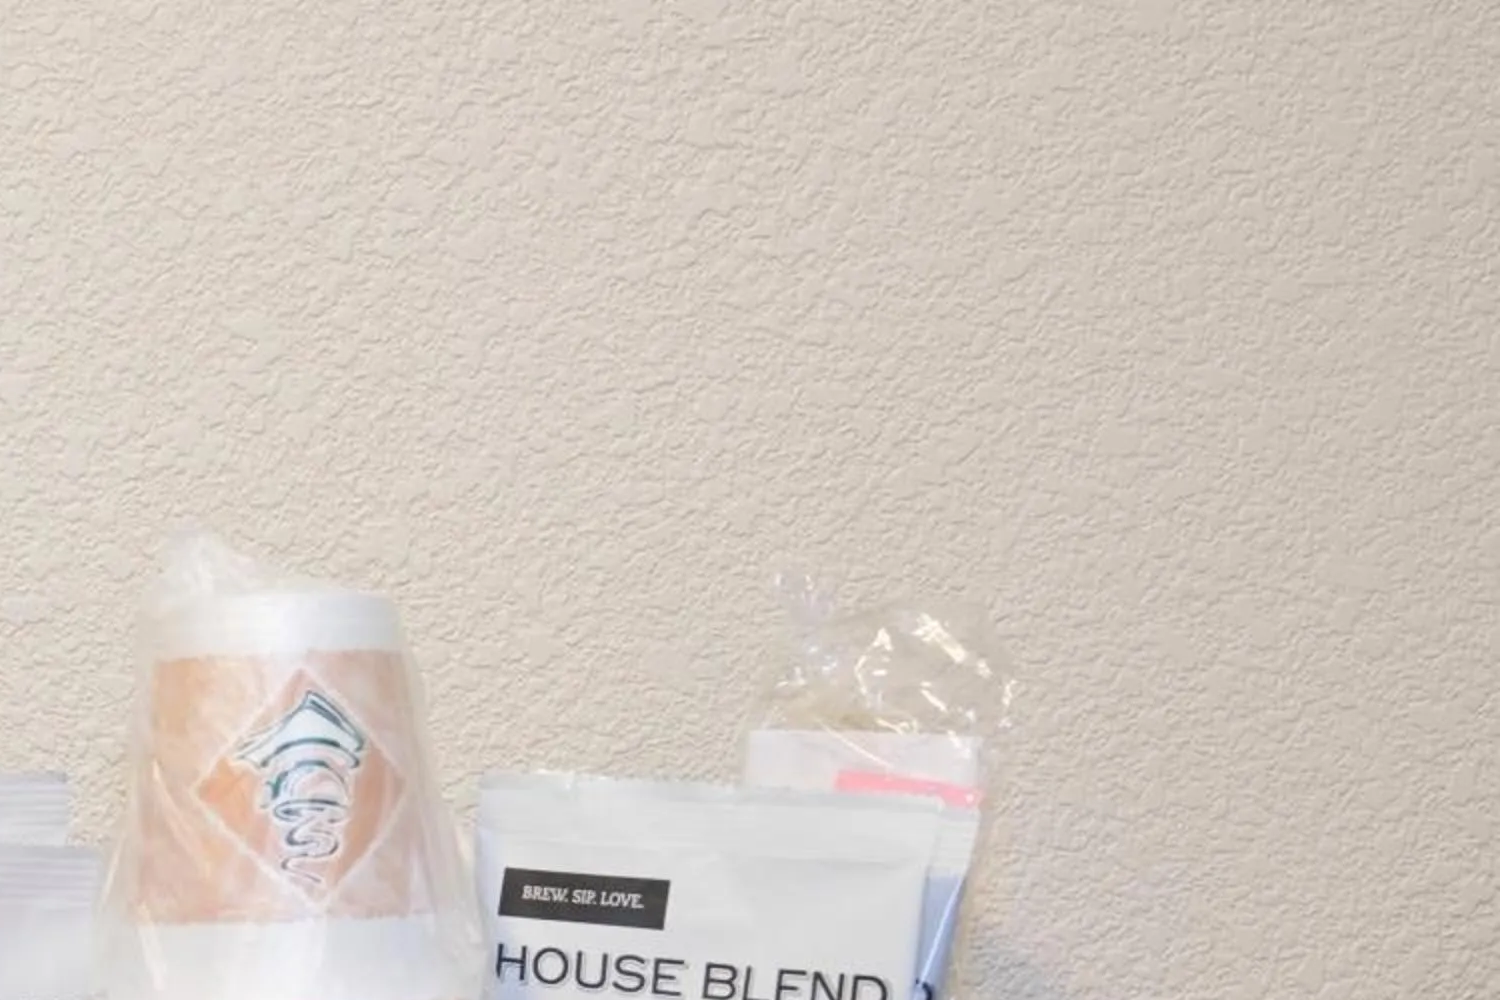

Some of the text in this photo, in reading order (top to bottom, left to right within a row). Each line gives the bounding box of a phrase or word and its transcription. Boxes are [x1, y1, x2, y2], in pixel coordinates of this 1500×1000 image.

[521, 885, 644, 909] BREW. SIP. LOVE.
[495, 943, 686, 997] HOUSE
